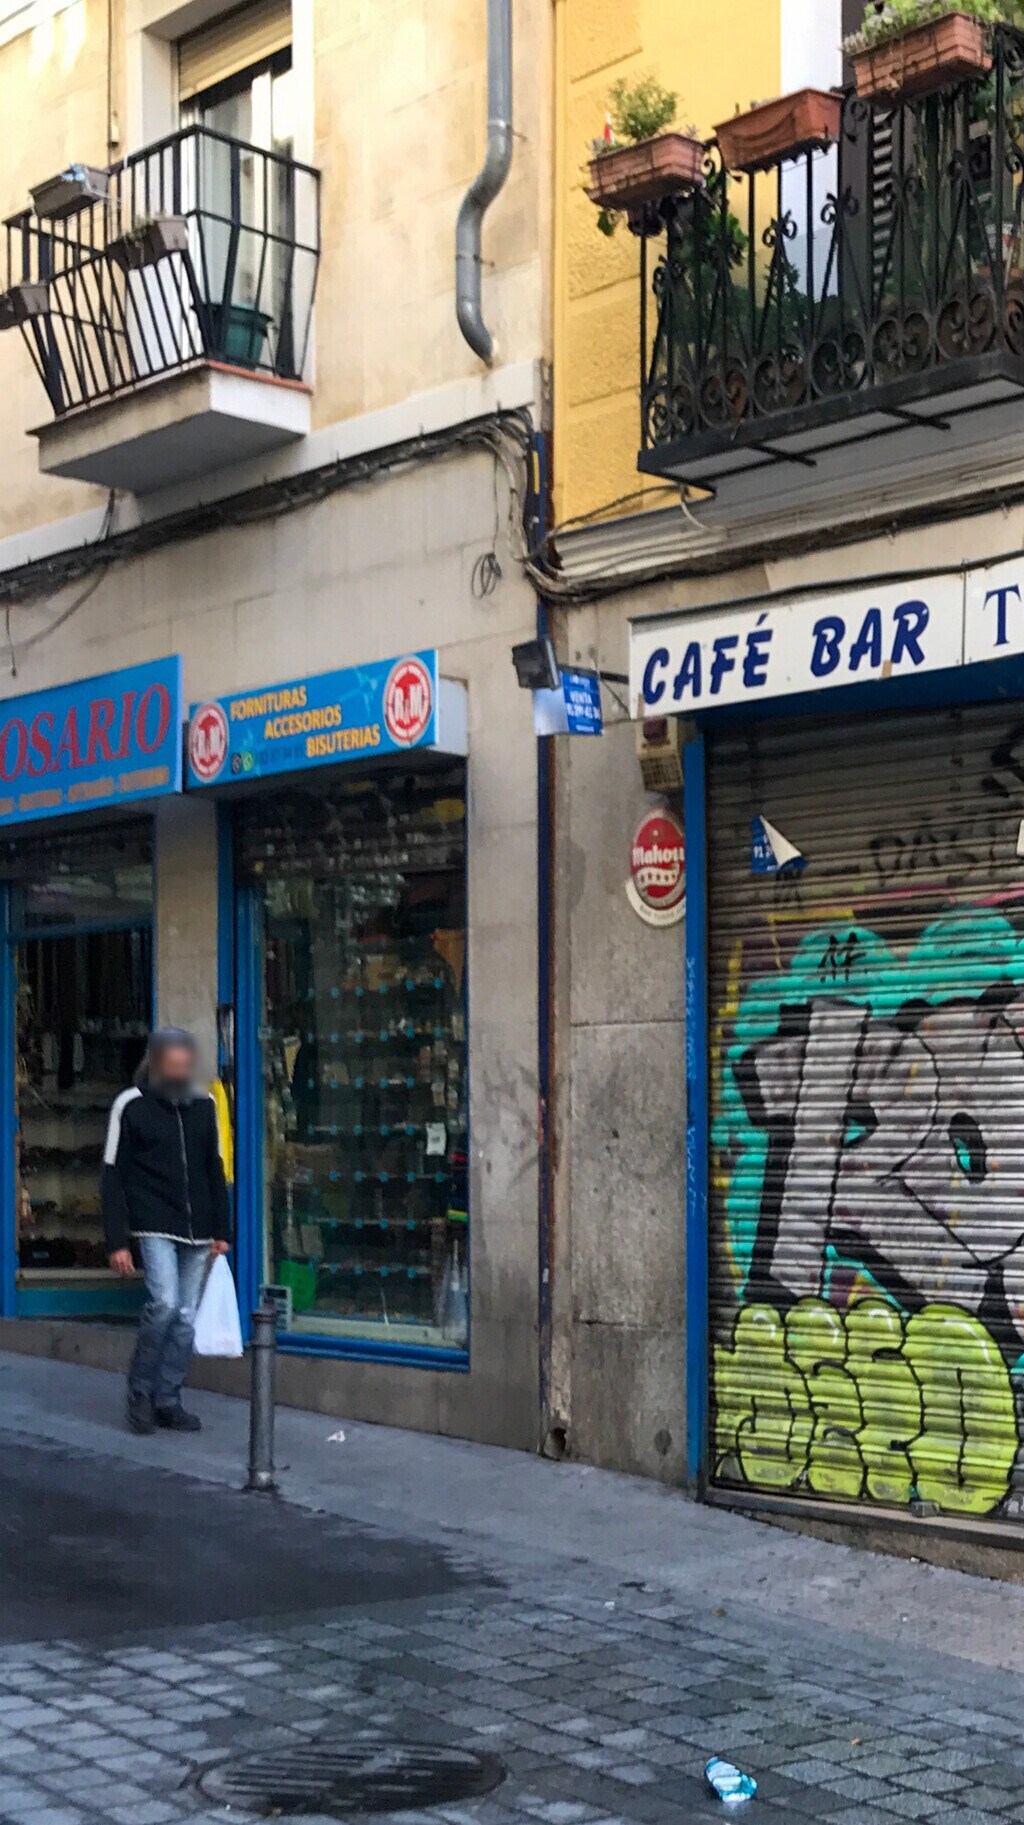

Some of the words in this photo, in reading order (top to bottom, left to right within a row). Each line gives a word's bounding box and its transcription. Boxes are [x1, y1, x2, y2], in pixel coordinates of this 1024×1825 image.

[642, 613, 773, 705] CAFÉ
[810, 599, 930, 678] BAR
[230, 686, 307, 722] FORNITURAS
[264, 704, 342, 740] ACCESORIOS
[0, 683, 171, 783] OSARIO
[306, 724, 380, 758] BISUTERIAS
[632, 844, 686, 867] Mahou
